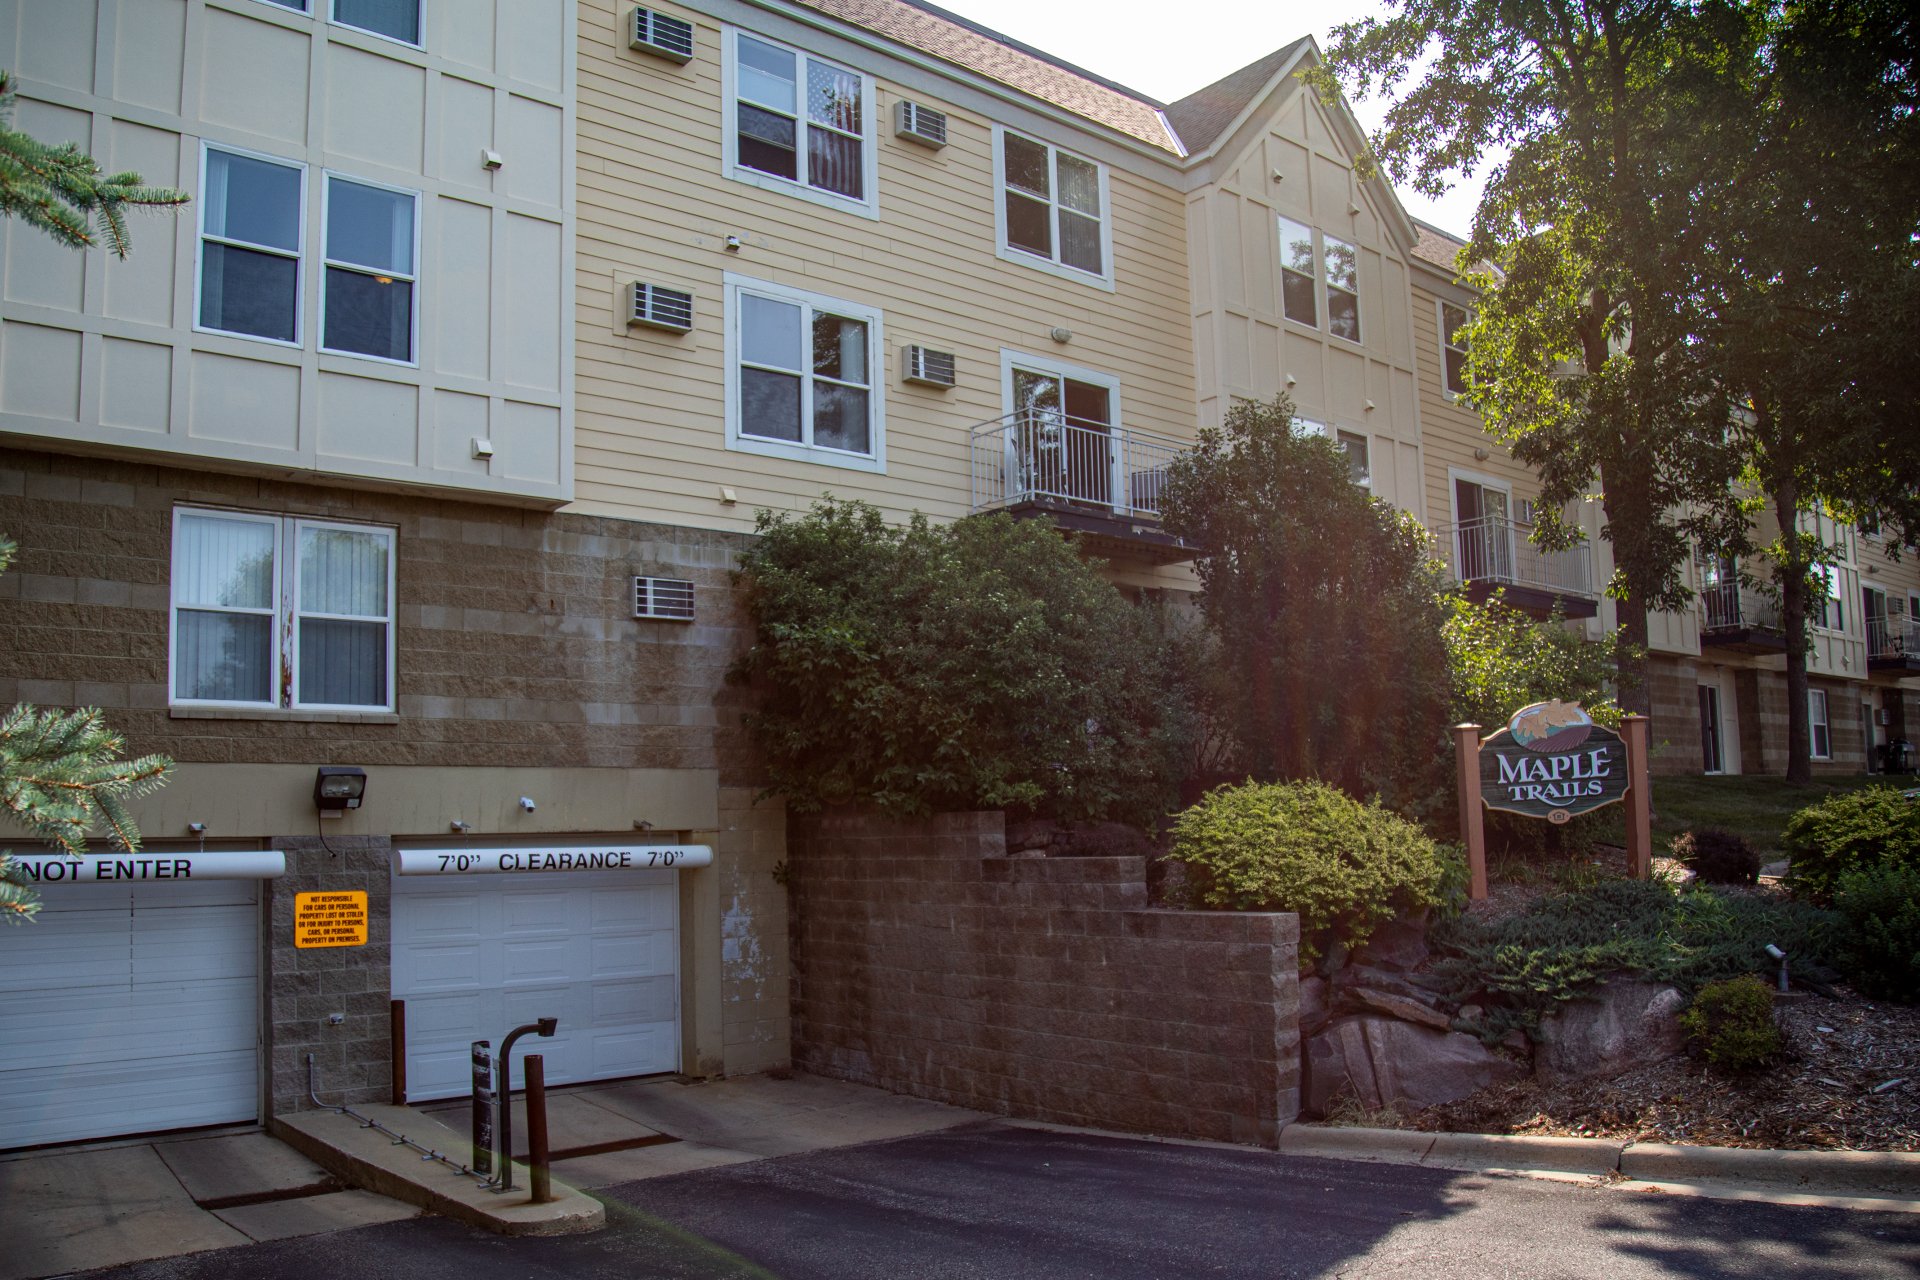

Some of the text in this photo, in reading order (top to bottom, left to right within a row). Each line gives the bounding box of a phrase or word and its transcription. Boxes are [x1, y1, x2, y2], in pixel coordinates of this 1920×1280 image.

[1496, 747, 1612, 785] MAPLE
[1508, 780, 1603, 807] TRAILS
[21, 859, 192, 881] NOT ENTER
[498, 851, 631, 871] CLEARANCE
